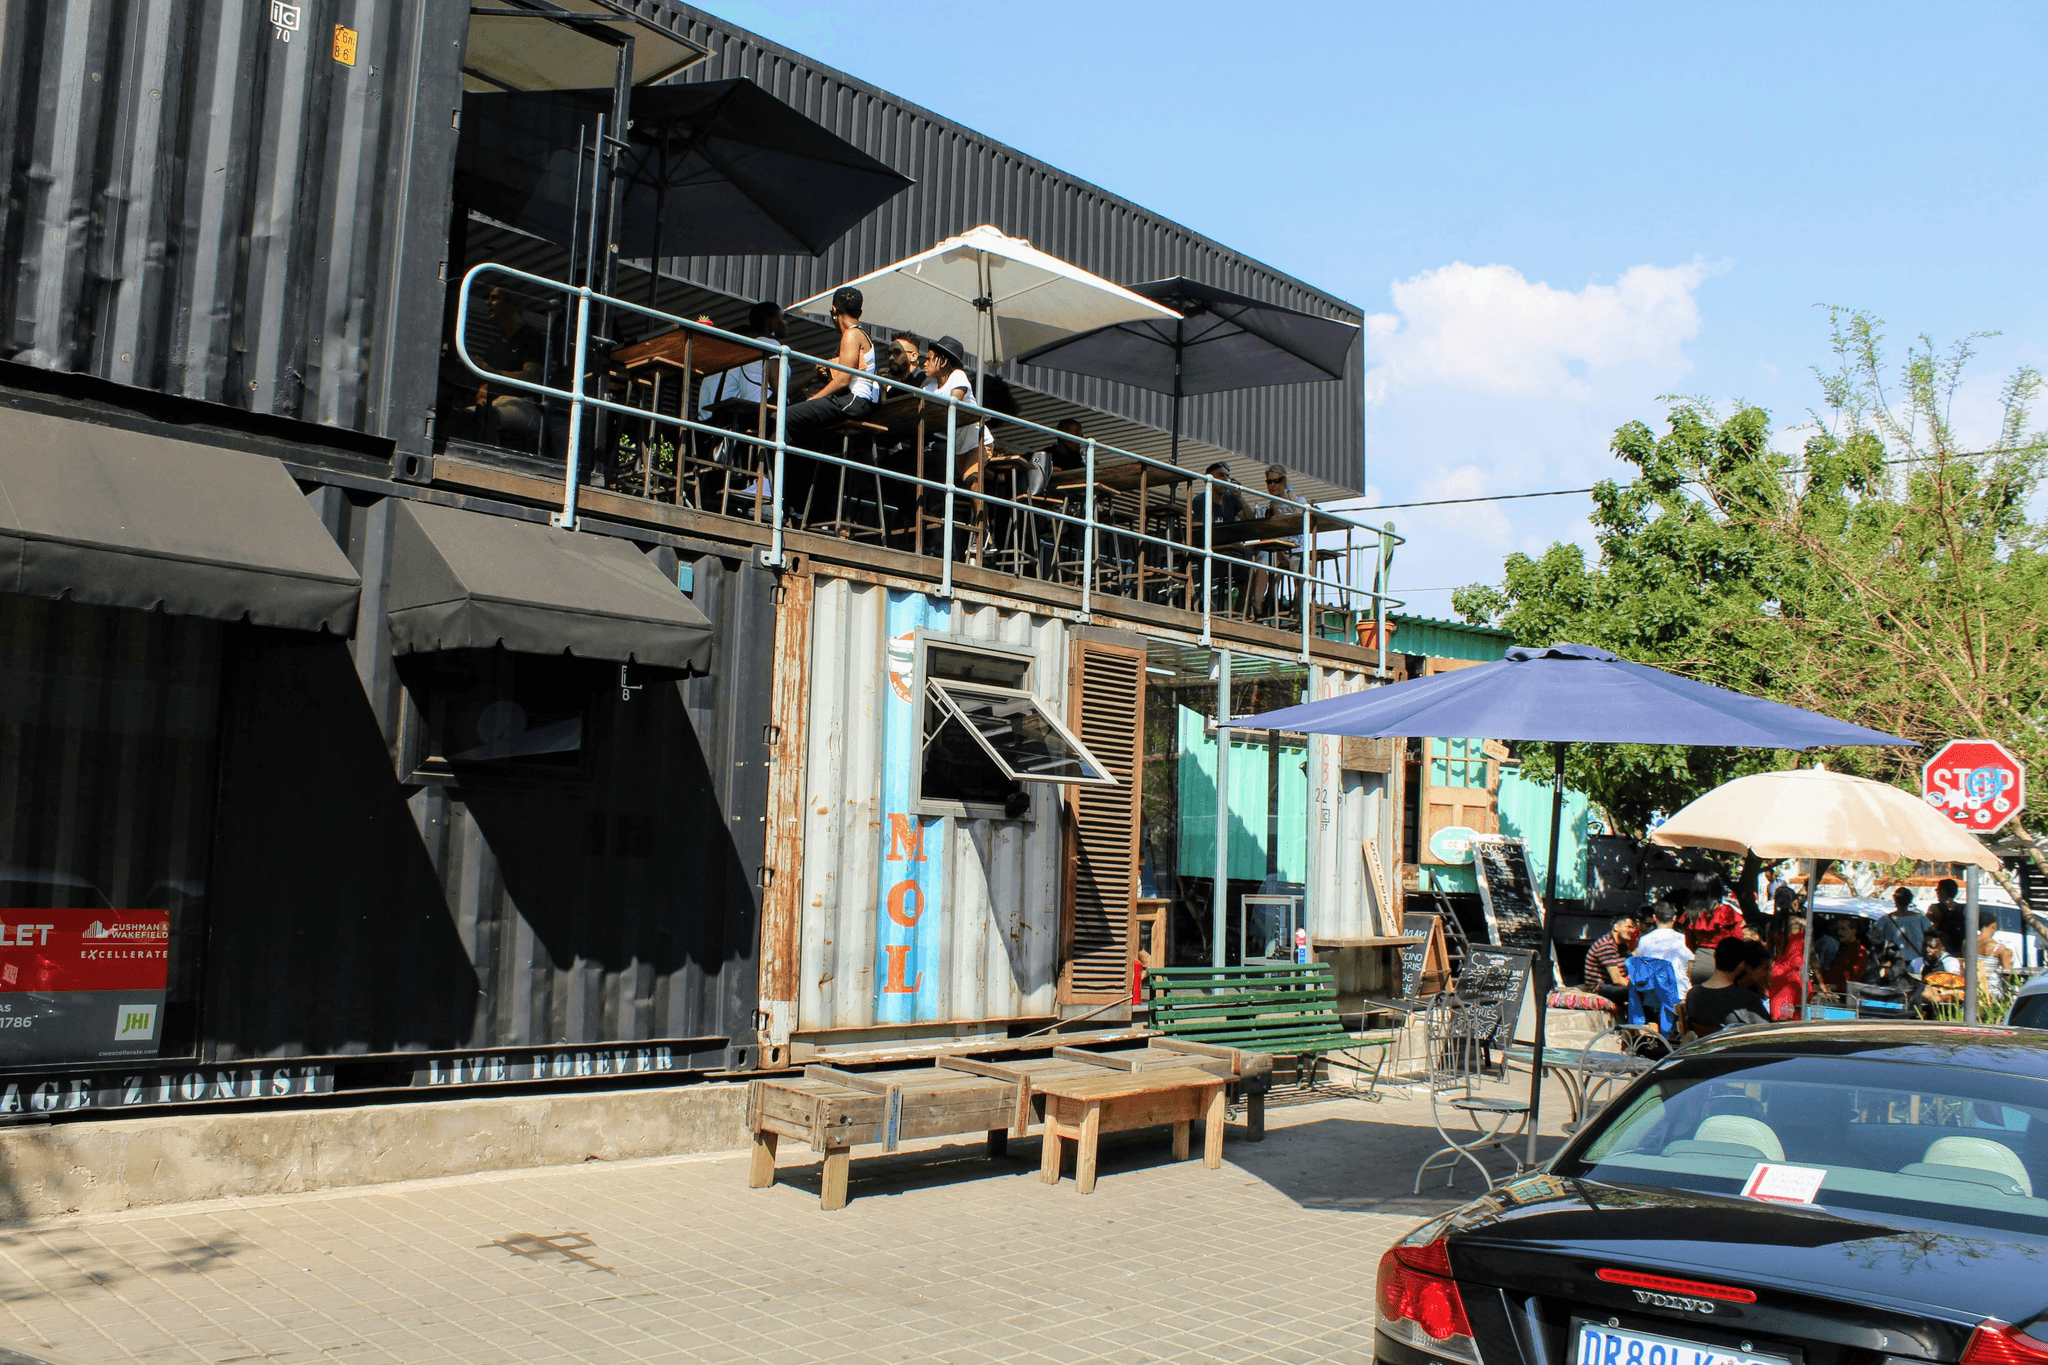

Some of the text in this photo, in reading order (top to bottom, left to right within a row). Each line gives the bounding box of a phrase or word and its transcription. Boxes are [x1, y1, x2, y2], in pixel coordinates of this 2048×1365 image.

[276, 27, 291, 43] 70
[883, 812, 928, 994] MOL
[0, 924, 55, 946] LET
[111, 931, 169, 939] WAKEFIELD
[112, 923, 168, 931] CUSHMAN &
[81, 949, 168, 960] EXCELLERATE
[0, 1016, 32, 1029] 1786
[122, 1013, 150, 1033] JHI
[98, 1049, 158, 1057] cwexcellerate.com
[429, 1047, 673, 1085] LIVE FOREVER
[123, 1065, 322, 1105] ZIONIST
[1632, 1289, 1715, 1314] VOLVO
